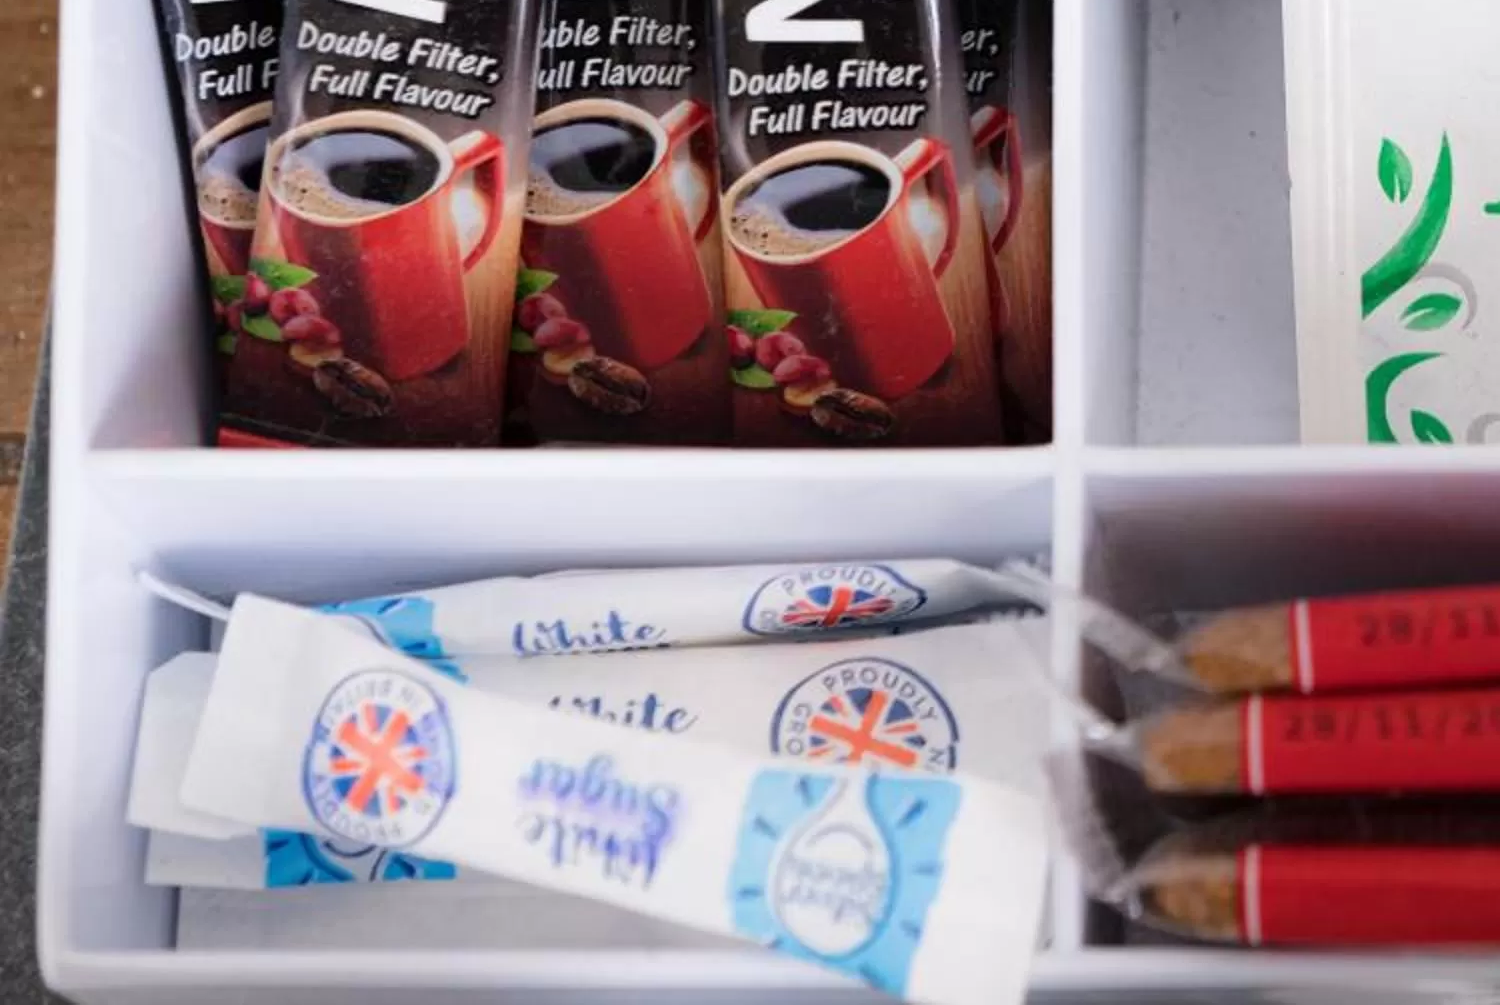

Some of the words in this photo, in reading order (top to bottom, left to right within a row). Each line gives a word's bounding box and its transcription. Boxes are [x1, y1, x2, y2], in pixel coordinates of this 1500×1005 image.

[176, 21, 275, 62] Double
[297, 20, 402, 64] Double
[405, 37, 501, 83] Filter,
[540, 18, 601, 48] uble
[608, 15, 696, 50] Filter,
[199, 64, 253, 99] Full
[309, 63, 367, 97] Full
[372, 76, 491, 118] Flavour
[538, 59, 575, 90] ull
[581, 57, 693, 89] Flavour
[729, 61, 829, 97] Double
[837, 57, 930, 93] Filter,
[748, 101, 804, 136] Full
[811, 98, 925, 133] Flavour
[512, 610, 667, 659] White
[822, 667, 940, 723] PROUDLY
